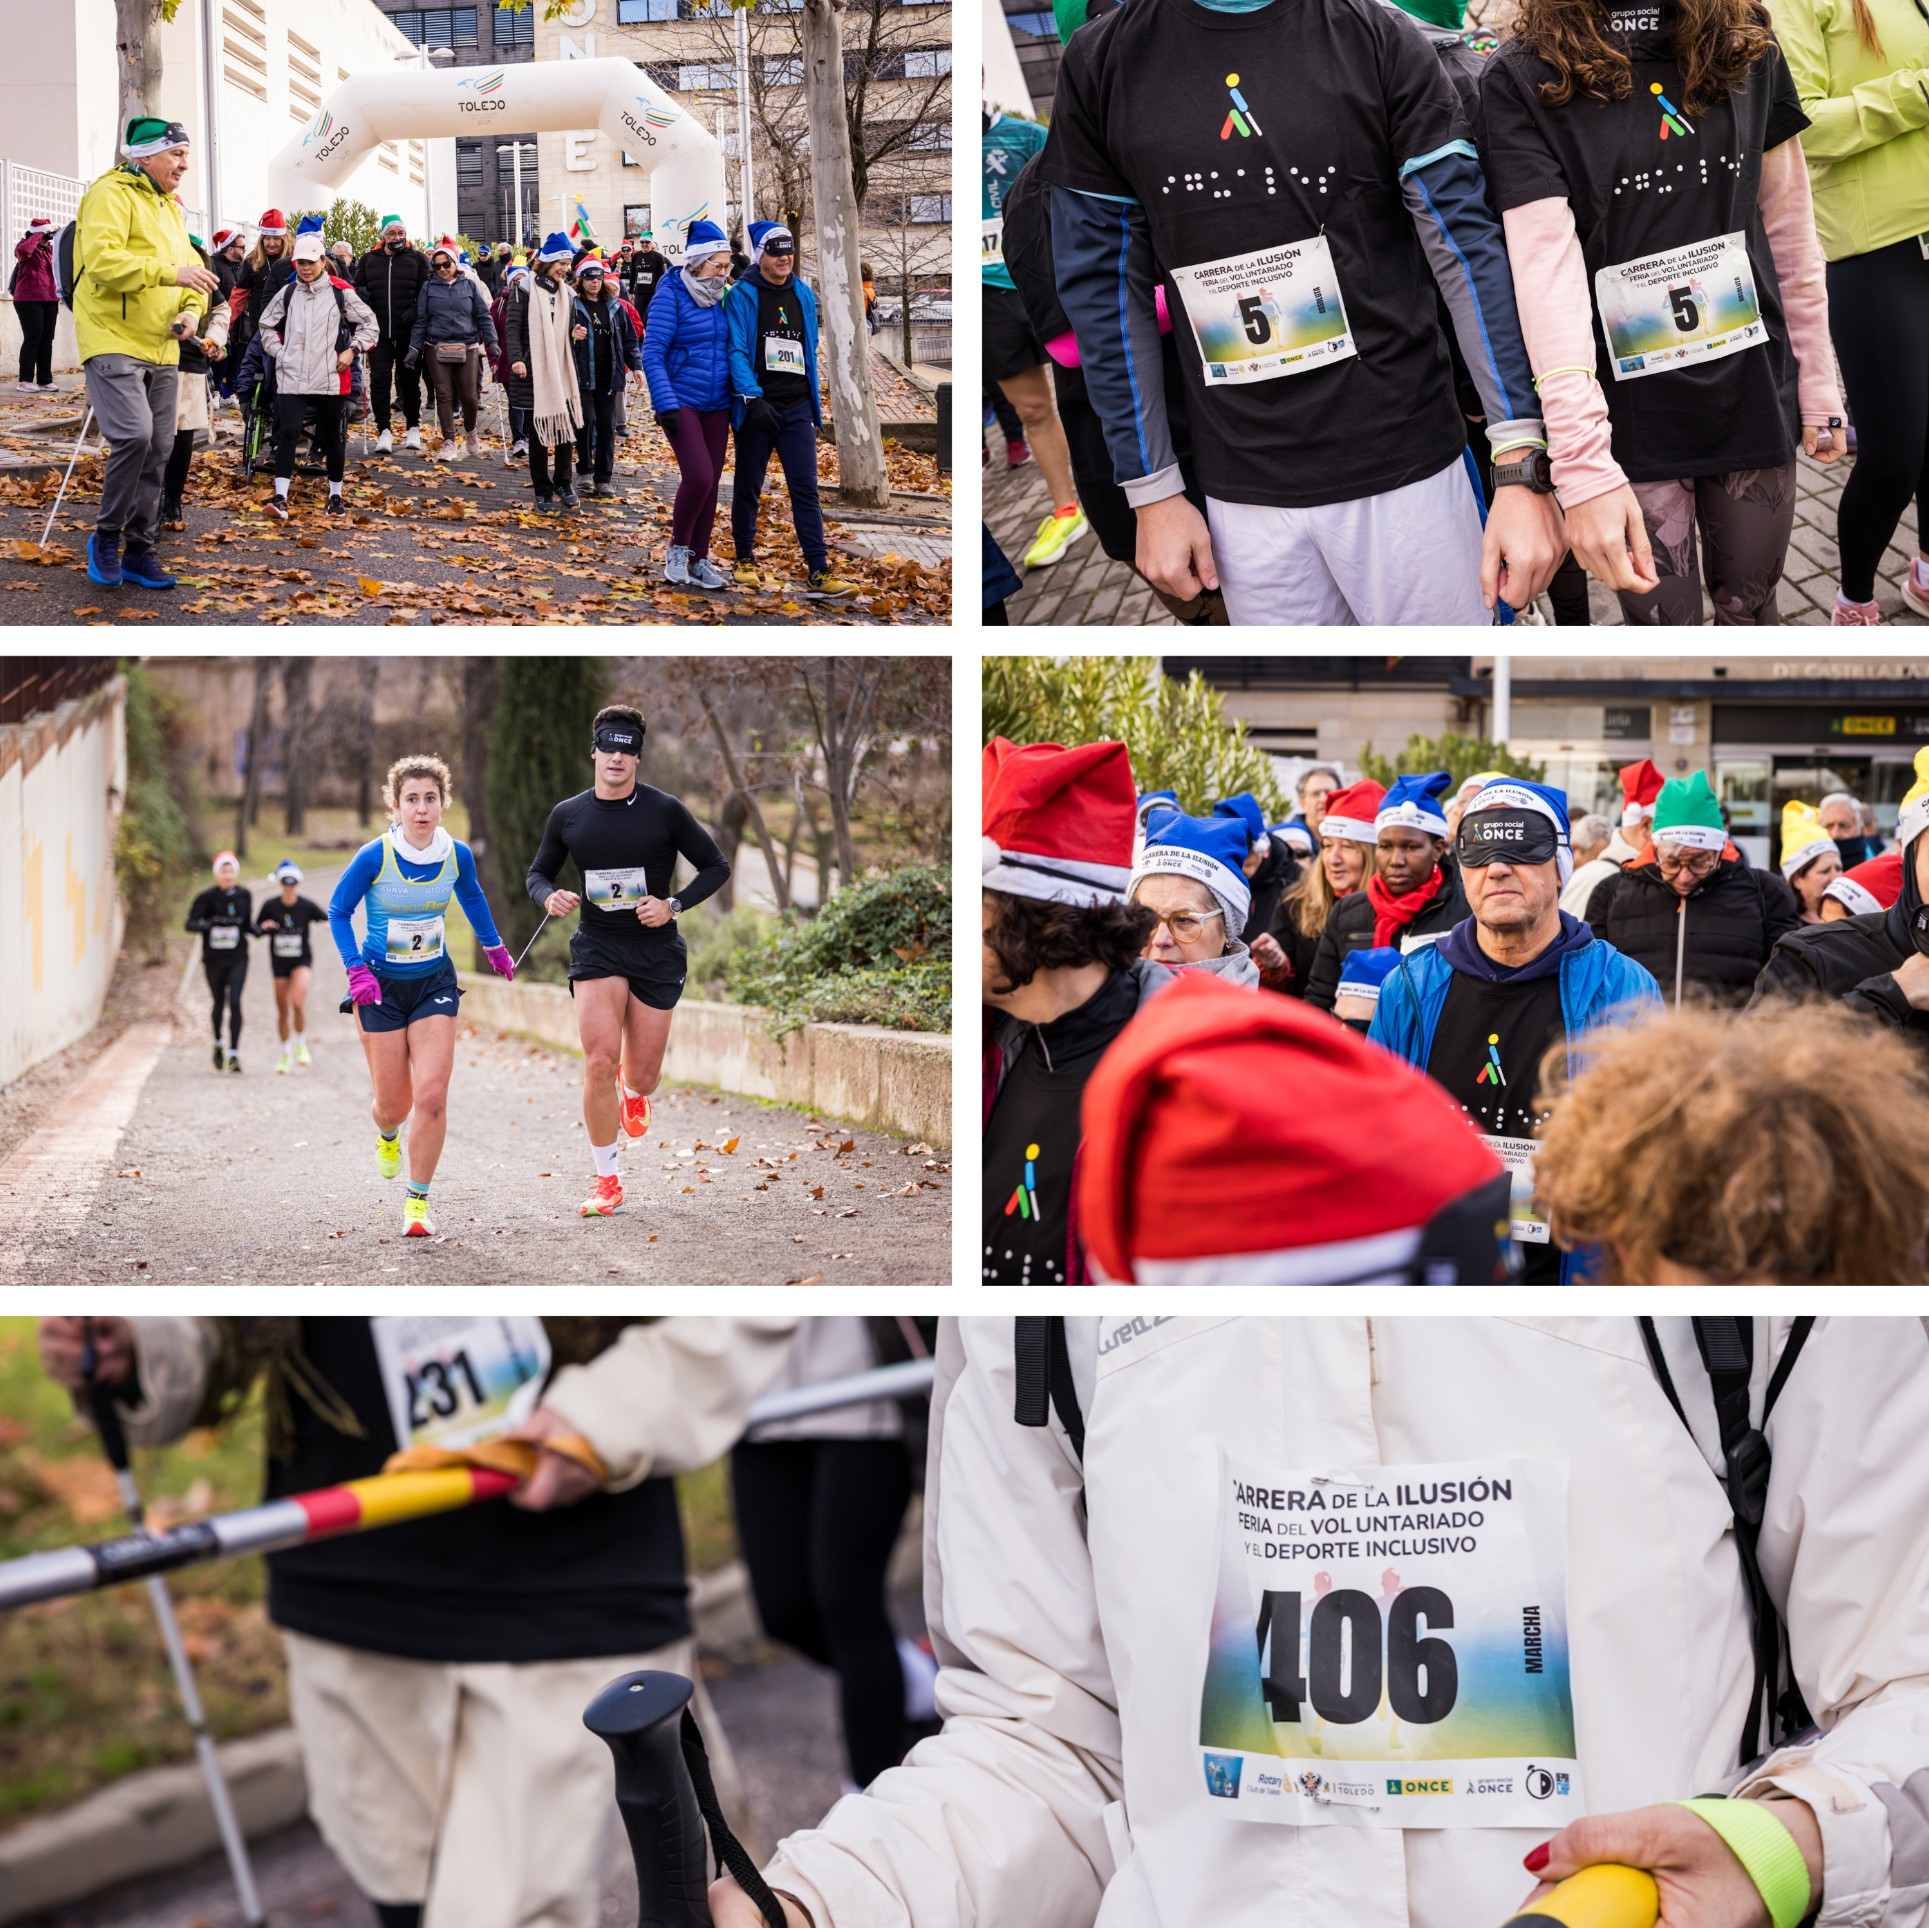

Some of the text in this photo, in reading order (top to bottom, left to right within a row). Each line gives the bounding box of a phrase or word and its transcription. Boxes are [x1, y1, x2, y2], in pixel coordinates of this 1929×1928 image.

[1611, 6, 1660, 19] grupo social
[1611, 17, 1659, 32] ONCE
[458, 100, 506, 112] TOLEDO
[619, 111, 657, 146] TOLEDO
[315, 126, 350, 162] TOLEDO
[988, 180, 1001, 208] CIVIL
[662, 245, 683, 255] TOL
[1621, 259, 1666, 276] CARRERA
[1667, 257, 1677, 265] DE
[1688, 242, 1725, 259] ILUSIÓN
[1194, 265, 1233, 280] CARRERA
[1235, 264, 1245, 272] DE
[1257, 249, 1301, 267] ILUSIÓN
[1648, 273, 1681, 286] DEPORTE
[1682, 262, 1719, 277] INCLUSIVO
[1202, 279, 1219, 287] FERIA
[1218, 280, 1250, 293] DEPORTE
[1251, 270, 1293, 286] INCLUSIVO
[1629, 272, 1650, 282] FERIA
[1734, 277, 1744, 302] ABSOLUTA
[1313, 287, 1326, 314] ABSOLUTA
[1668, 286, 1699, 332] 5
[1238, 296, 1272, 344] 5
[1713, 340, 1726, 348] ONCE
[778, 350, 795, 363] 201
[1483, 829, 1524, 841] ONCE
[1142, 850, 1168, 860] CARRERA
[1181, 851, 1191, 859] LA
[1192, 855, 1219, 872] ILUSIÓN
[381, 885, 409, 893] CURVA
[611, 884, 622, 899] 2
[412, 935, 422, 951] 2
[1503, 1142, 1536, 1151] ILUSIÓN
[1233, 1476, 1512, 1511] ARRERA DE LA ILUSIÓN
[1239, 1512, 1272, 1534] FERIA
[1277, 1522, 1307, 1536] DEL
[1244, 1536, 1477, 1560] Y EL DEPORTE INCLUSIVO
[1523, 1605, 1544, 1674] MARCHA
[1256, 1585, 1459, 1725] 406
[1257, 1773, 1282, 1788] Rotary
[1405, 1780, 1449, 1792] ONCE
[1478, 1784, 1513, 1793] ONCE
[1338, 1786, 1375, 1796] TOLEDO
